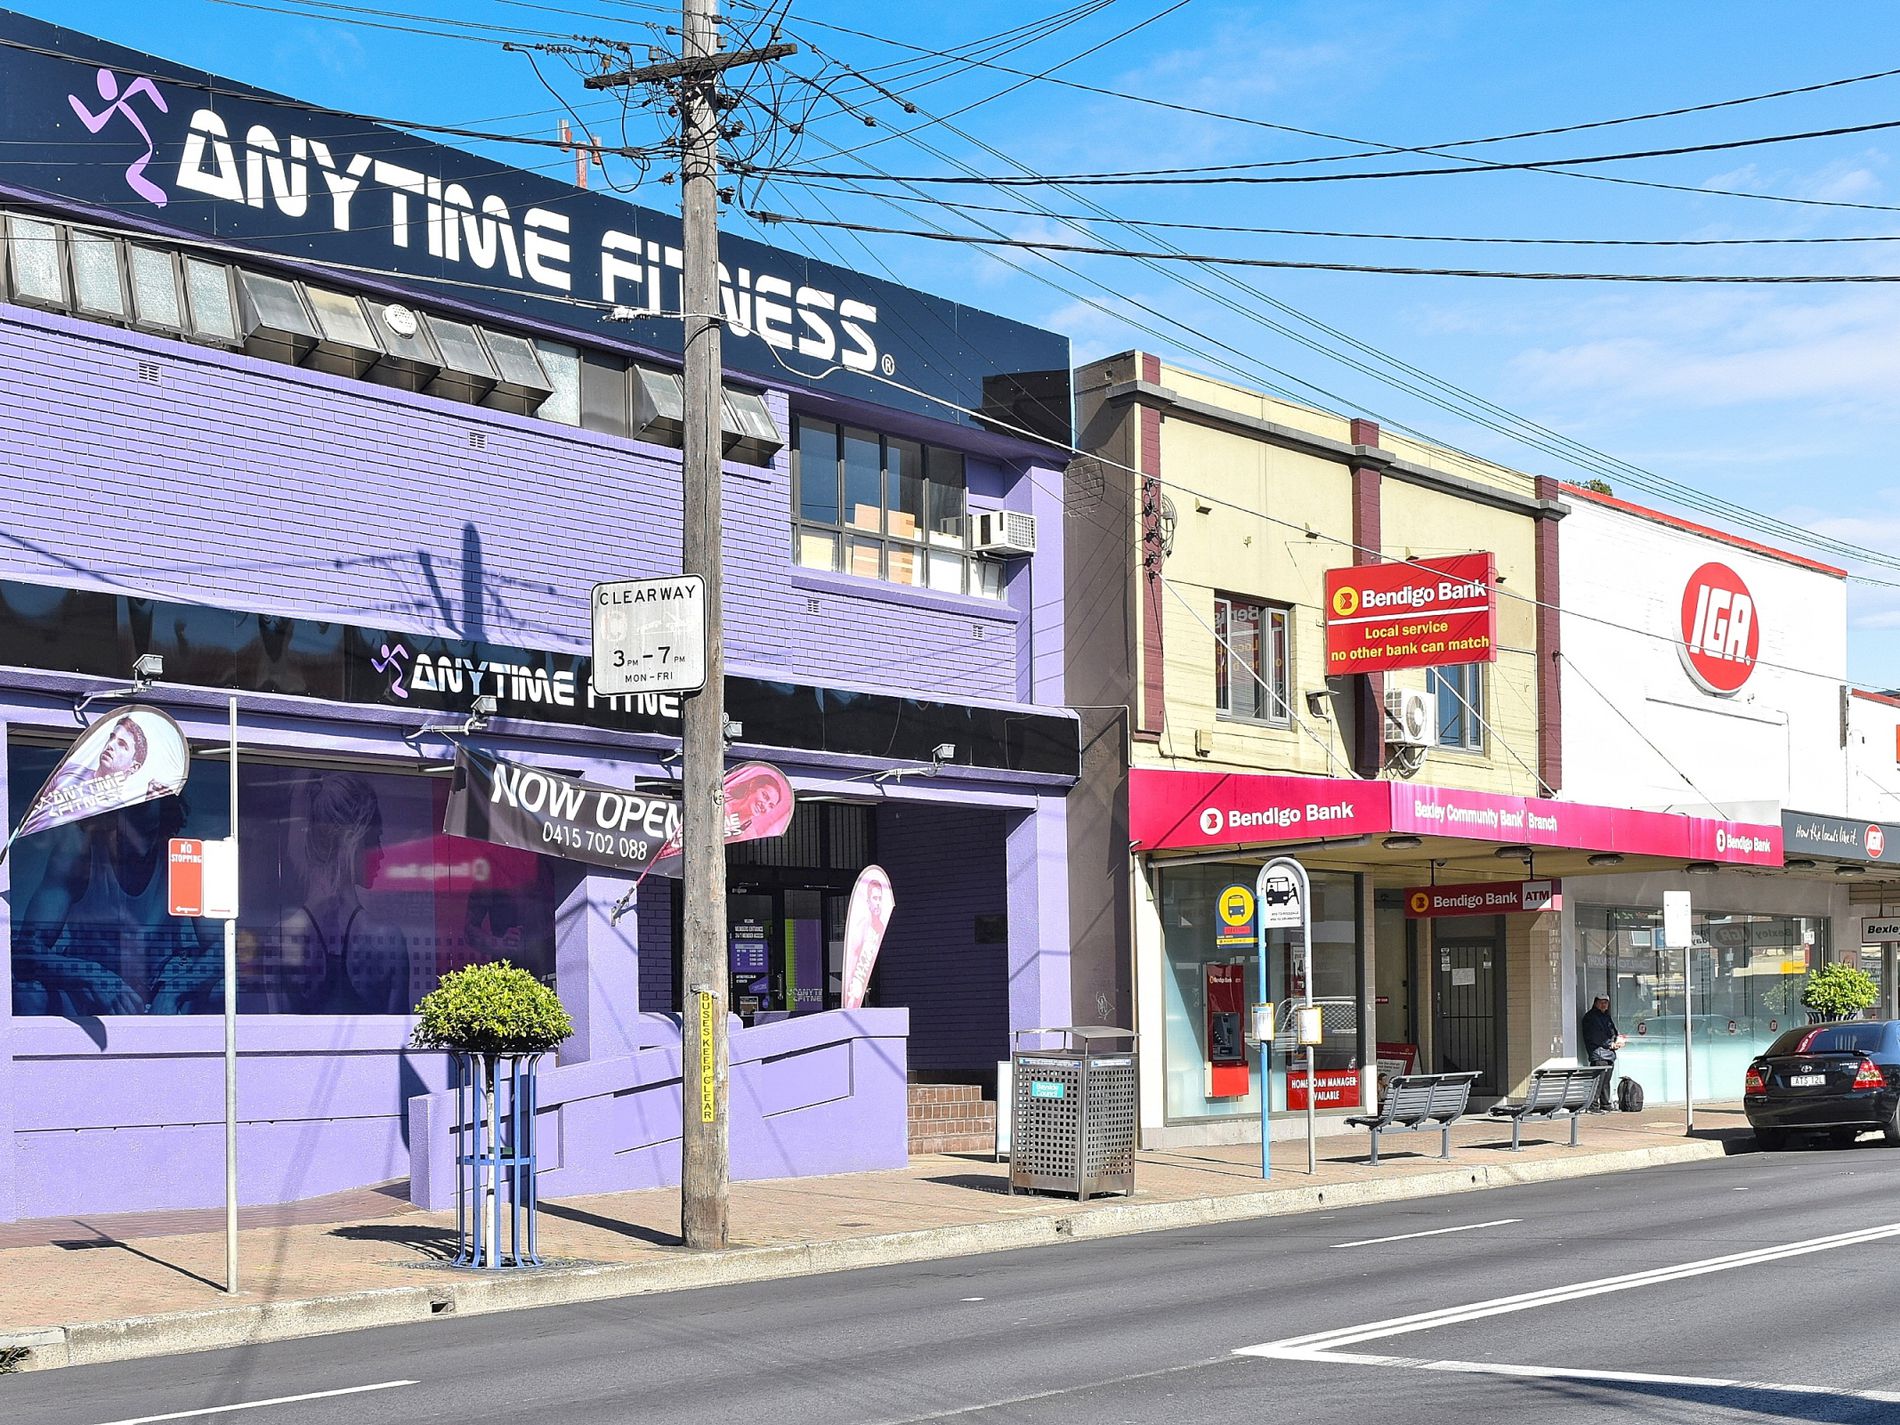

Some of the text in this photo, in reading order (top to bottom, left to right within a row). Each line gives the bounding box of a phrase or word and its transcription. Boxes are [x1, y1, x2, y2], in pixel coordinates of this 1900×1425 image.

[176, 109, 571, 291] ANYTIME
[600, 585, 696, 606] CLEARWAY
[1361, 579, 1487, 608] Bendigo Bank
[1364, 621, 1449, 639] Local service
[1690, 584, 1752, 663] IGA
[1331, 635, 1489, 662] no other bank can match
[411, 653, 575, 707] ANYTIME
[53, 773, 127, 803] ANYTIME
[491, 763, 587, 821] NOW
[595, 790, 684, 841] OPEN
[1228, 801, 1354, 828] Bendigo Bank
[1414, 801, 1558, 832] Bexley Community Bank Branch
[542, 820, 648, 862] 0415 702 088
[1727, 834, 1771, 854] Bendigo Bank
[1796, 824, 1810, 838] How
[1810, 822, 1821, 842] the
[1821, 824, 1838, 843] locals
[170, 854, 202, 864] STOPPING
[181, 843, 193, 853] NO
[1434, 890, 1550, 909] Bendigo Bank ATM
[1867, 924, 1900, 935] Bexle
[702, 992, 712, 1119] BUSES KEEP CLEAR
[1291, 1079, 1308, 1090] HOME
[1312, 1078, 1327, 1088] OAN
[1313, 1091, 1340, 1101] VAILABLE
